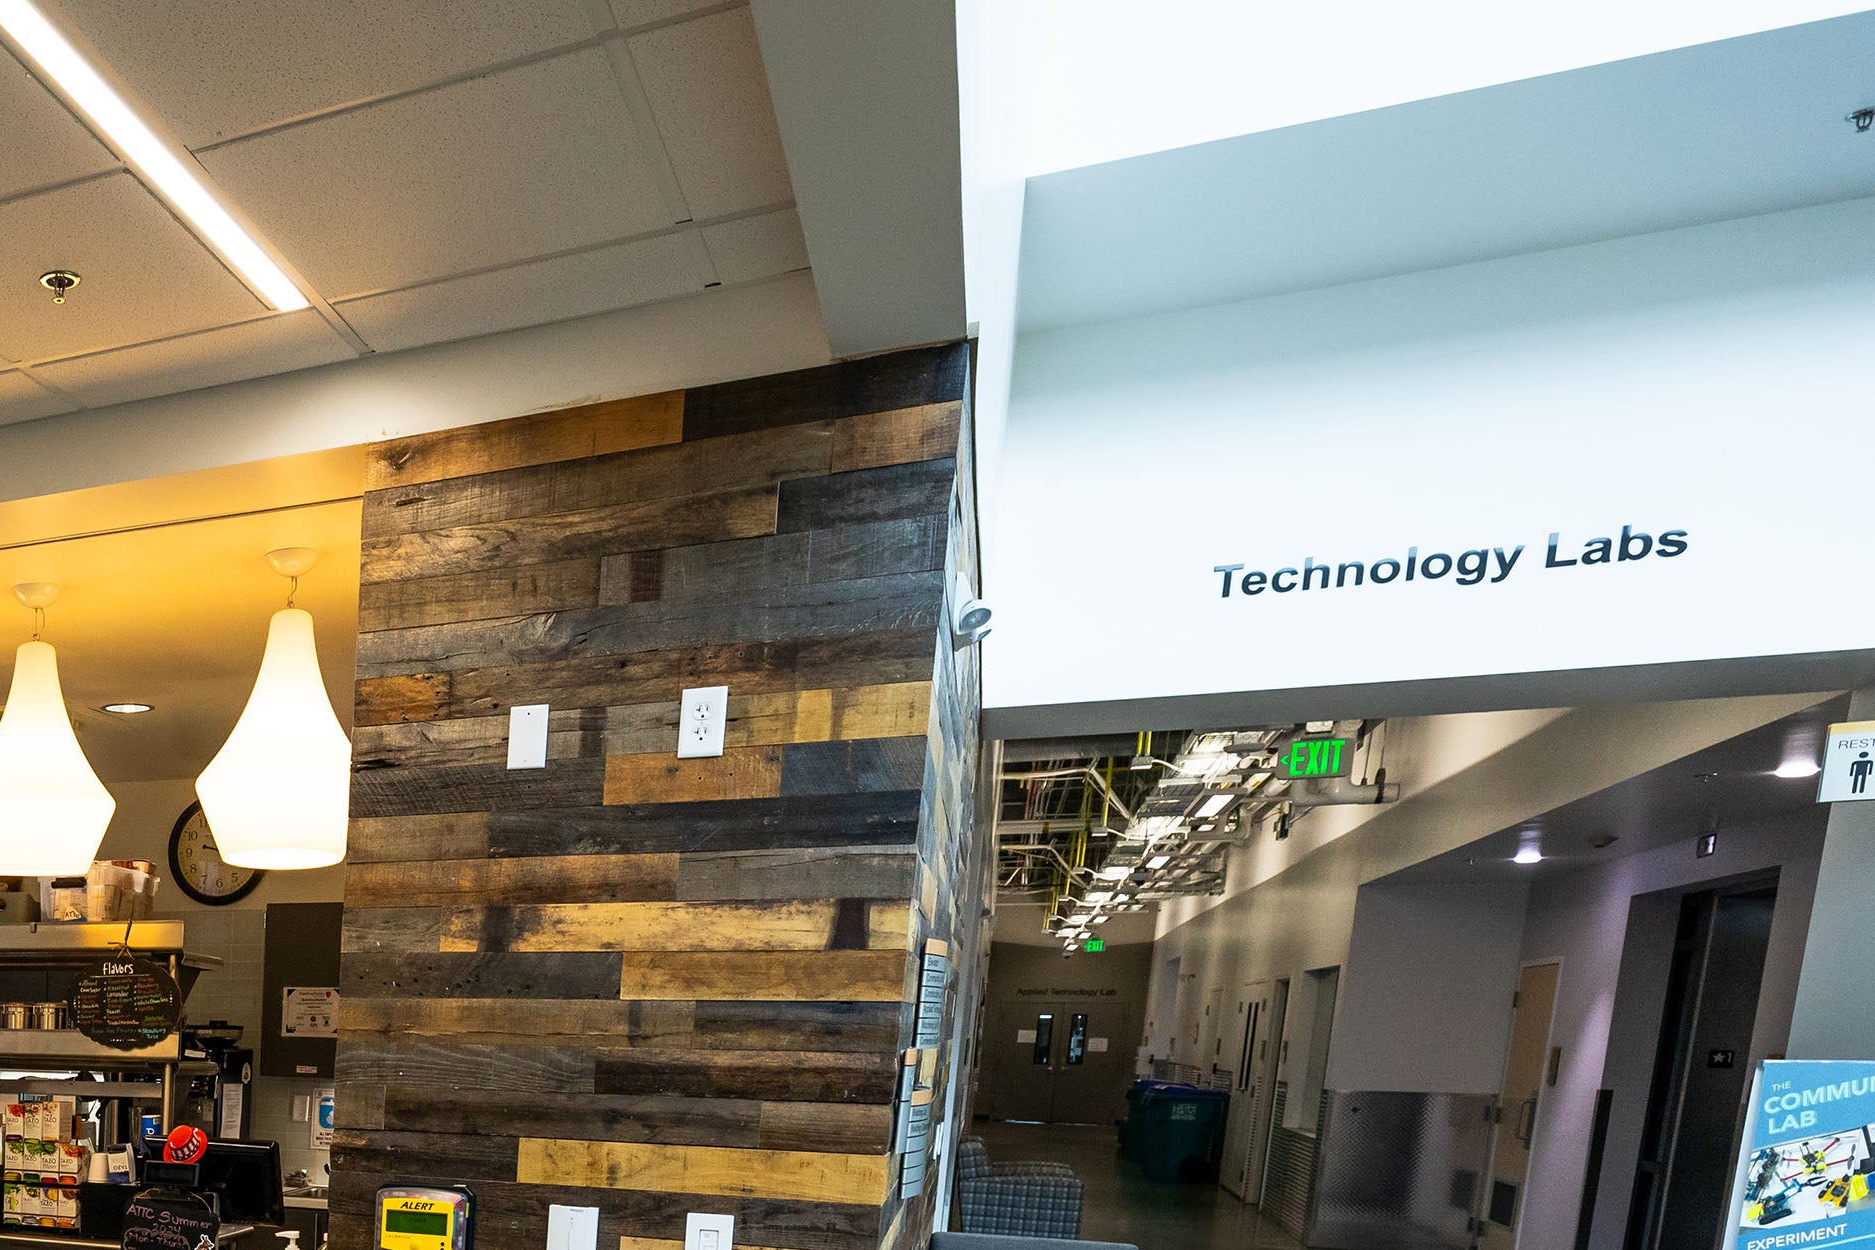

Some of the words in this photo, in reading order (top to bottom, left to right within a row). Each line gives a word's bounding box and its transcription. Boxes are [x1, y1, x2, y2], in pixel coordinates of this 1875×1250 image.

[1214, 544, 1525, 598] Technology
[1545, 524, 1689, 568] Labs
[1289, 740, 1347, 777] EXIT
[188, 831, 198, 841] 10
[185, 848, 193, 857] 9
[190, 864, 197, 873] 8
[201, 875, 208, 885] 7
[215, 878, 223, 888] 6
[231, 873, 238, 883] 5
[1086, 939, 1104, 953] EXIT
[1771, 1081, 1791, 1092] THE
[1768, 1110, 1818, 1135] LAB
[42, 1157, 57, 1165] TAZO
[400, 1201, 435, 1211] ALERT
[125, 1203, 155, 1219] ATTC
[158, 1211, 213, 1229] Summer
[152, 1223, 181, 1236] 2024
